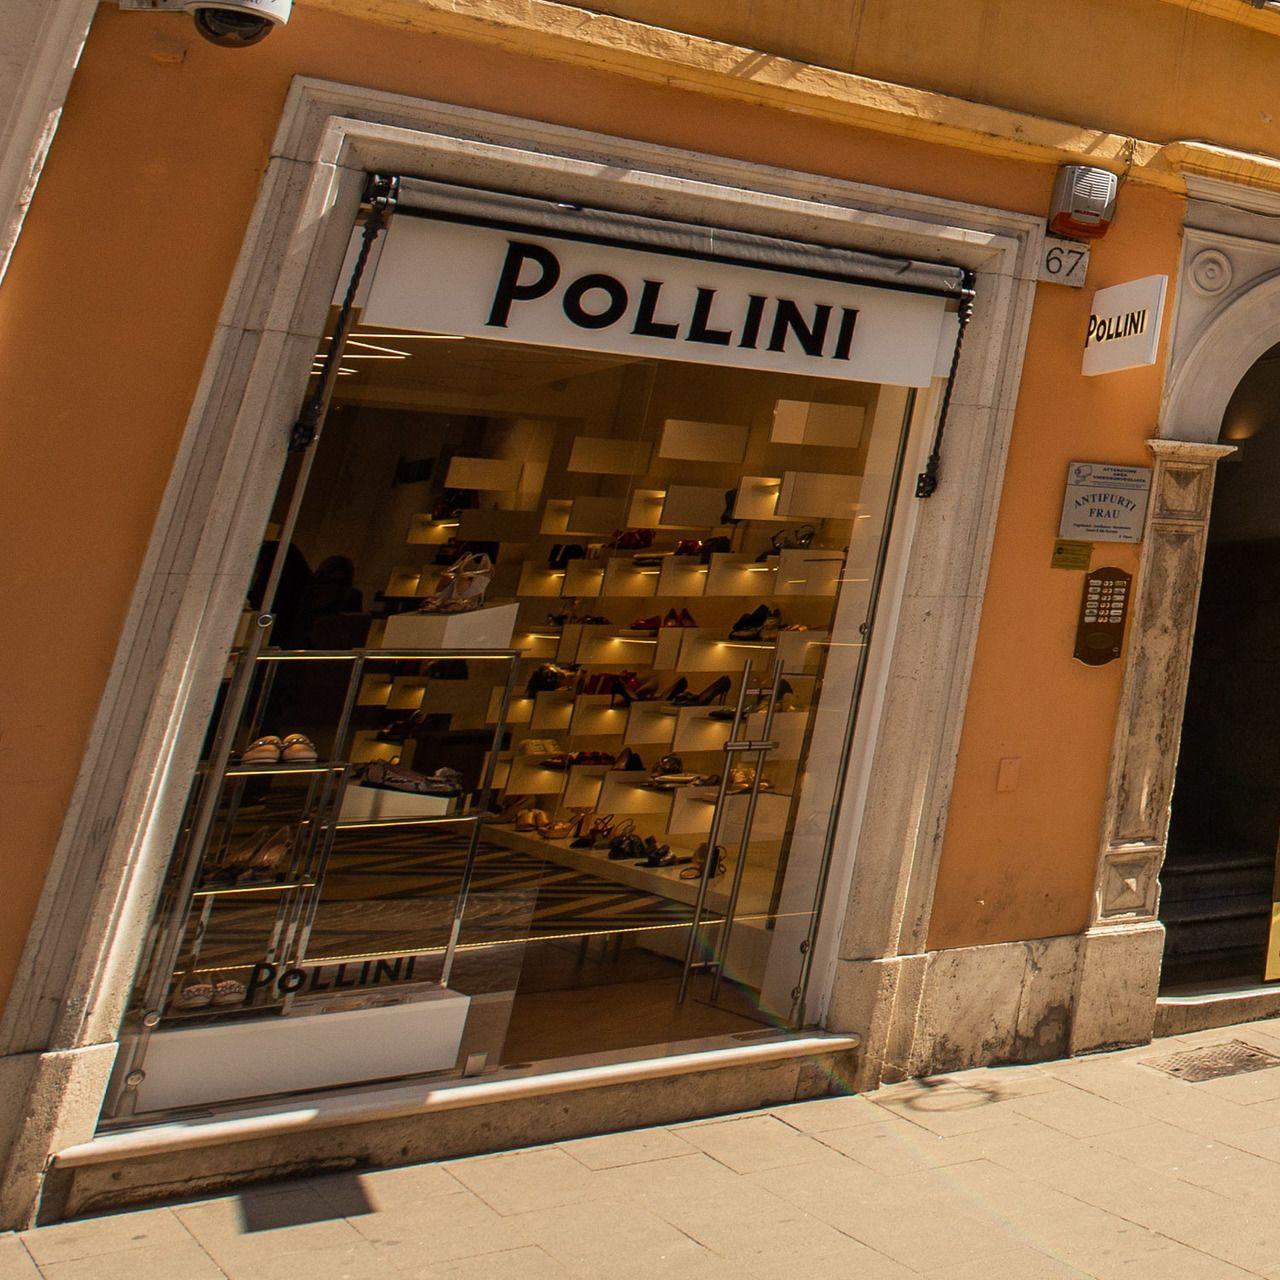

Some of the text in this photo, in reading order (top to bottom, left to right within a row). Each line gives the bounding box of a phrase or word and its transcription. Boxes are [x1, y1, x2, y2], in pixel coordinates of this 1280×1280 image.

[1045, 246, 1085, 277] 67
[485, 240, 860, 361] POLLINI
[1084, 309, 1147, 348] POLLINI
[1073, 493, 1137, 512] ANTIFURTI
[1088, 507, 1120, 519] FRAU
[247, 955, 417, 1004] POLLINI
